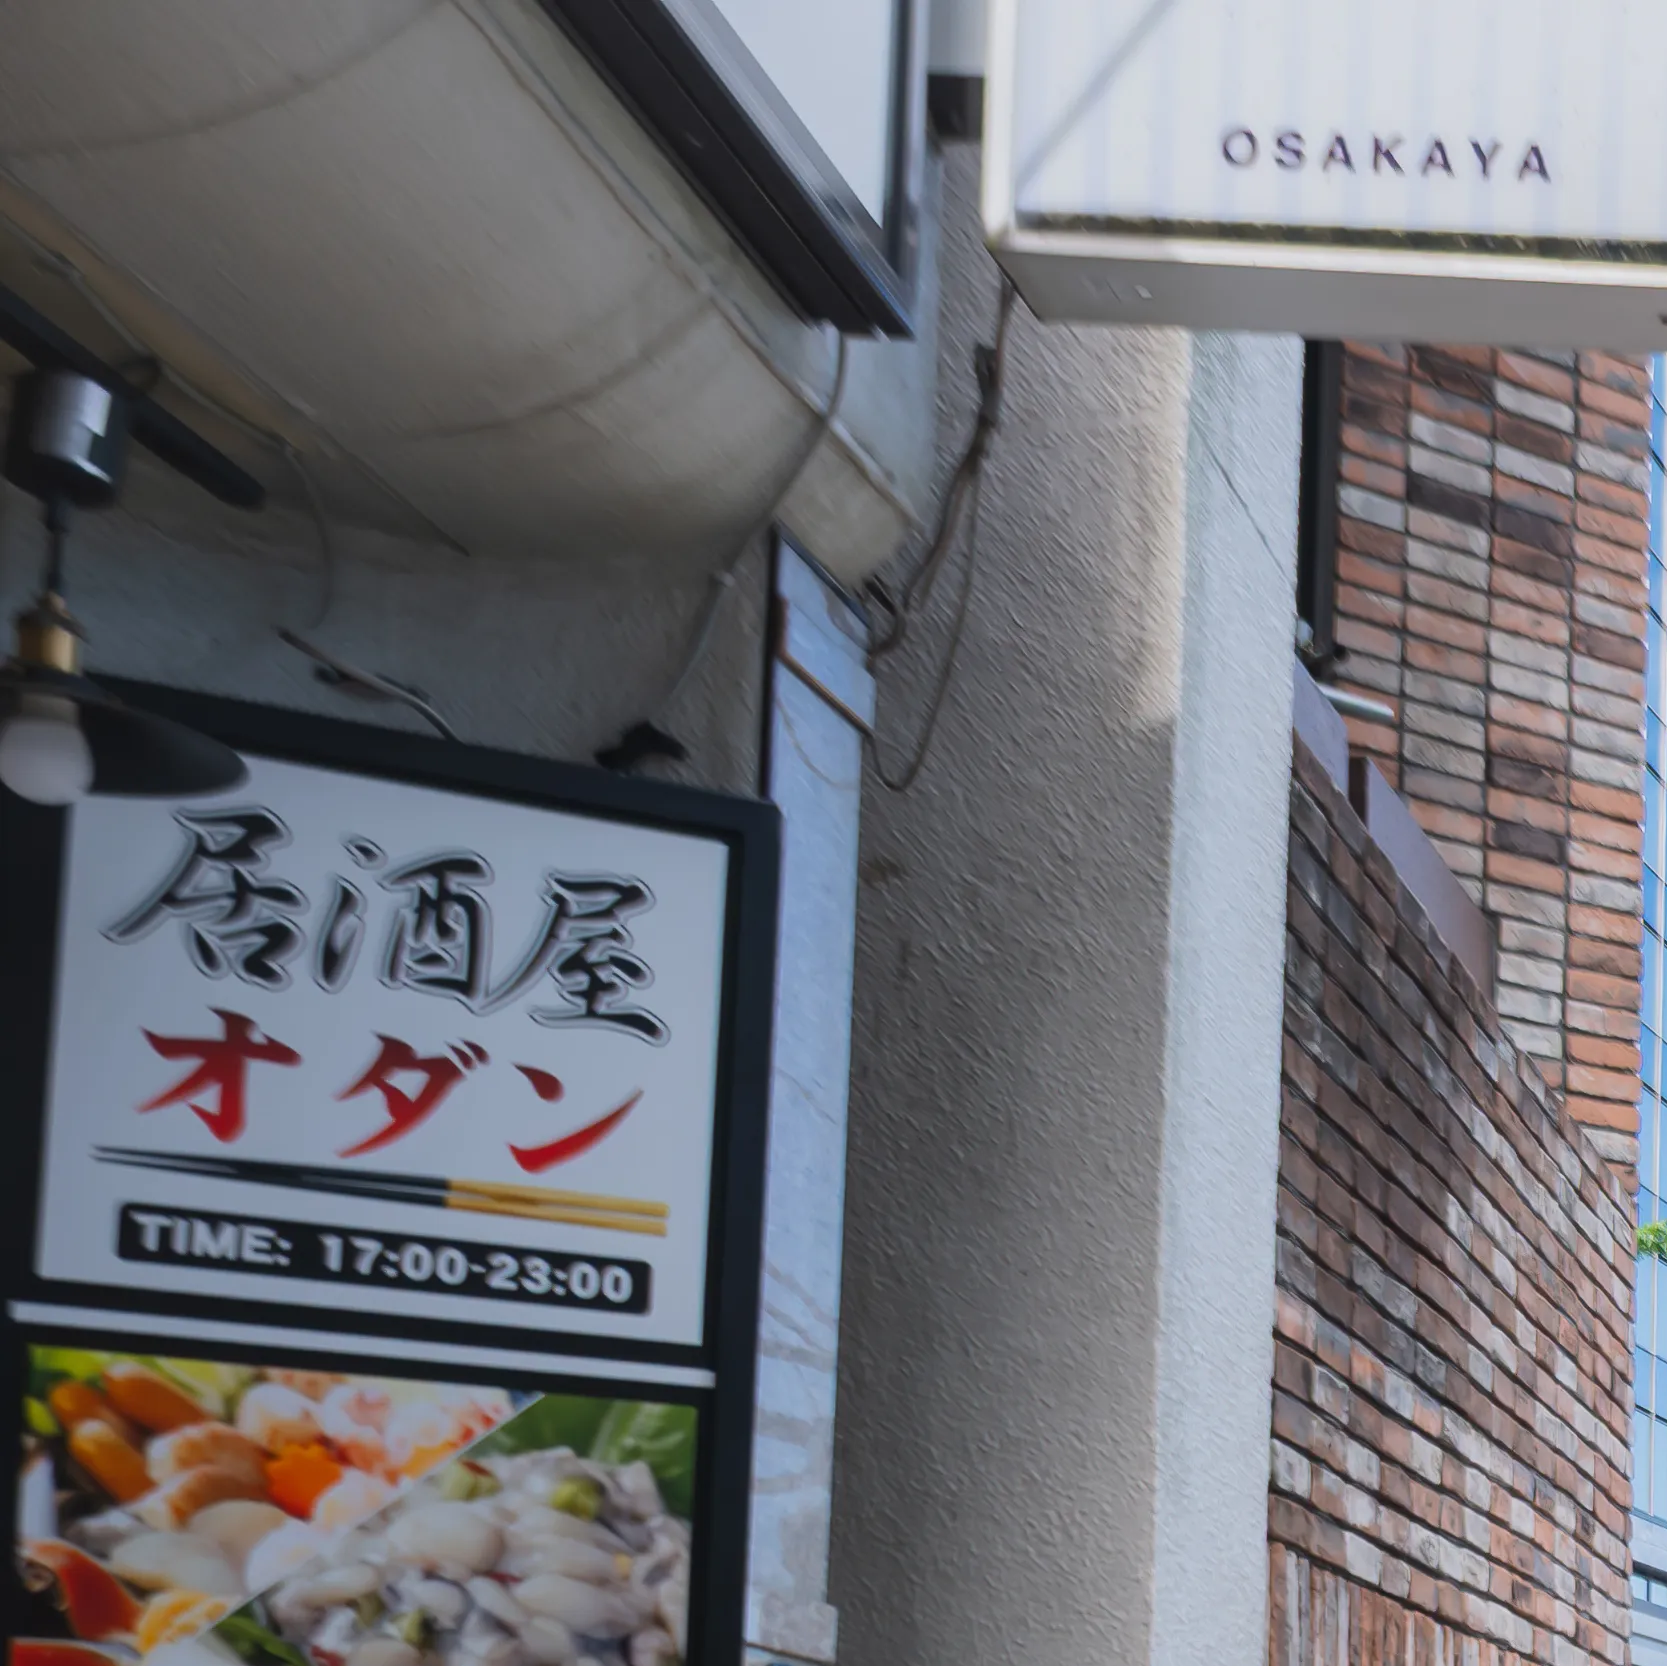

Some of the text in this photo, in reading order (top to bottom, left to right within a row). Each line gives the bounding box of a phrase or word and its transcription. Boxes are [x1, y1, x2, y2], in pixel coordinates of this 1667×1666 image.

[1220, 126, 1553, 184] OSAKAYA
[98, 804, 672, 1047] 居酒屋
[135, 1005, 645, 1175] オダン
[129, 1212, 634, 1305] TIME: 17:00-23:00
